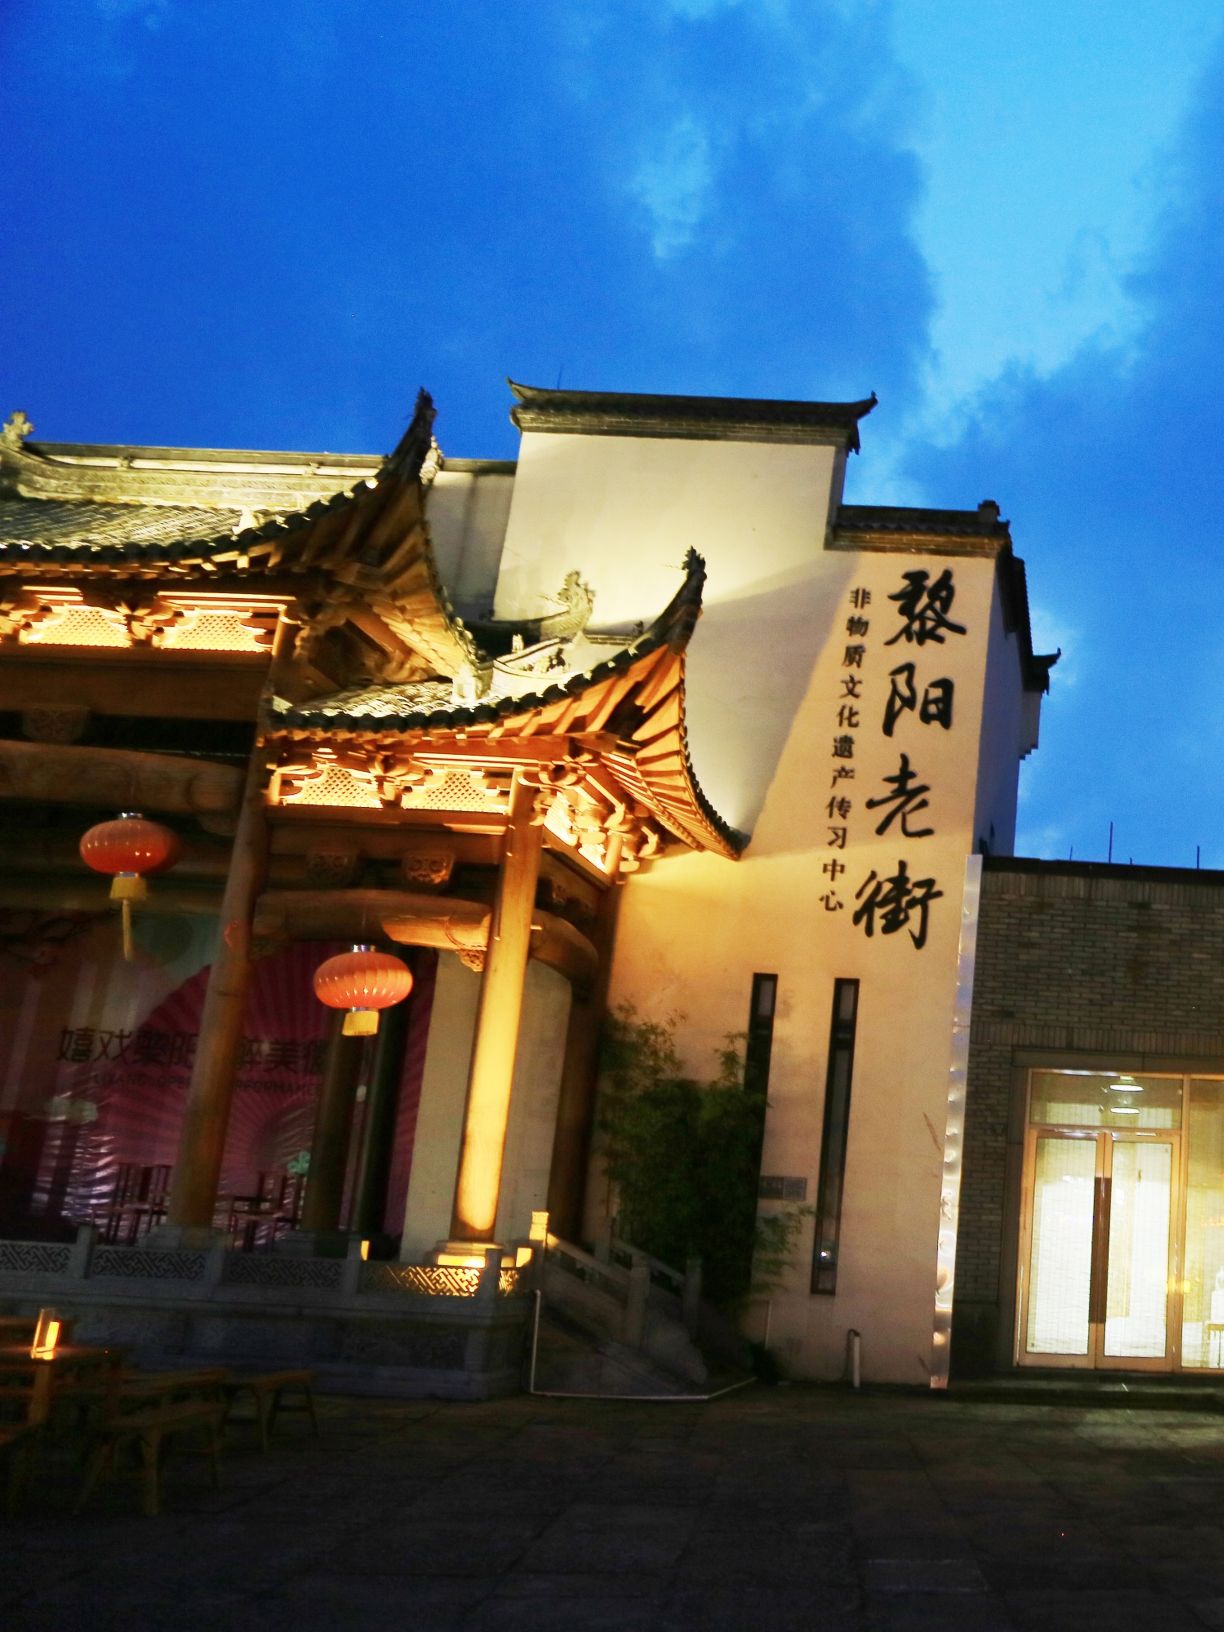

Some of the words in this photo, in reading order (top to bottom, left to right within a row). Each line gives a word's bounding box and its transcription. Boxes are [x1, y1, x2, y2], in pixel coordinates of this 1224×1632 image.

[819, 587, 871, 912] 非物质文化遗产传习中心
[852, 568, 967, 950] 黎阳老街
